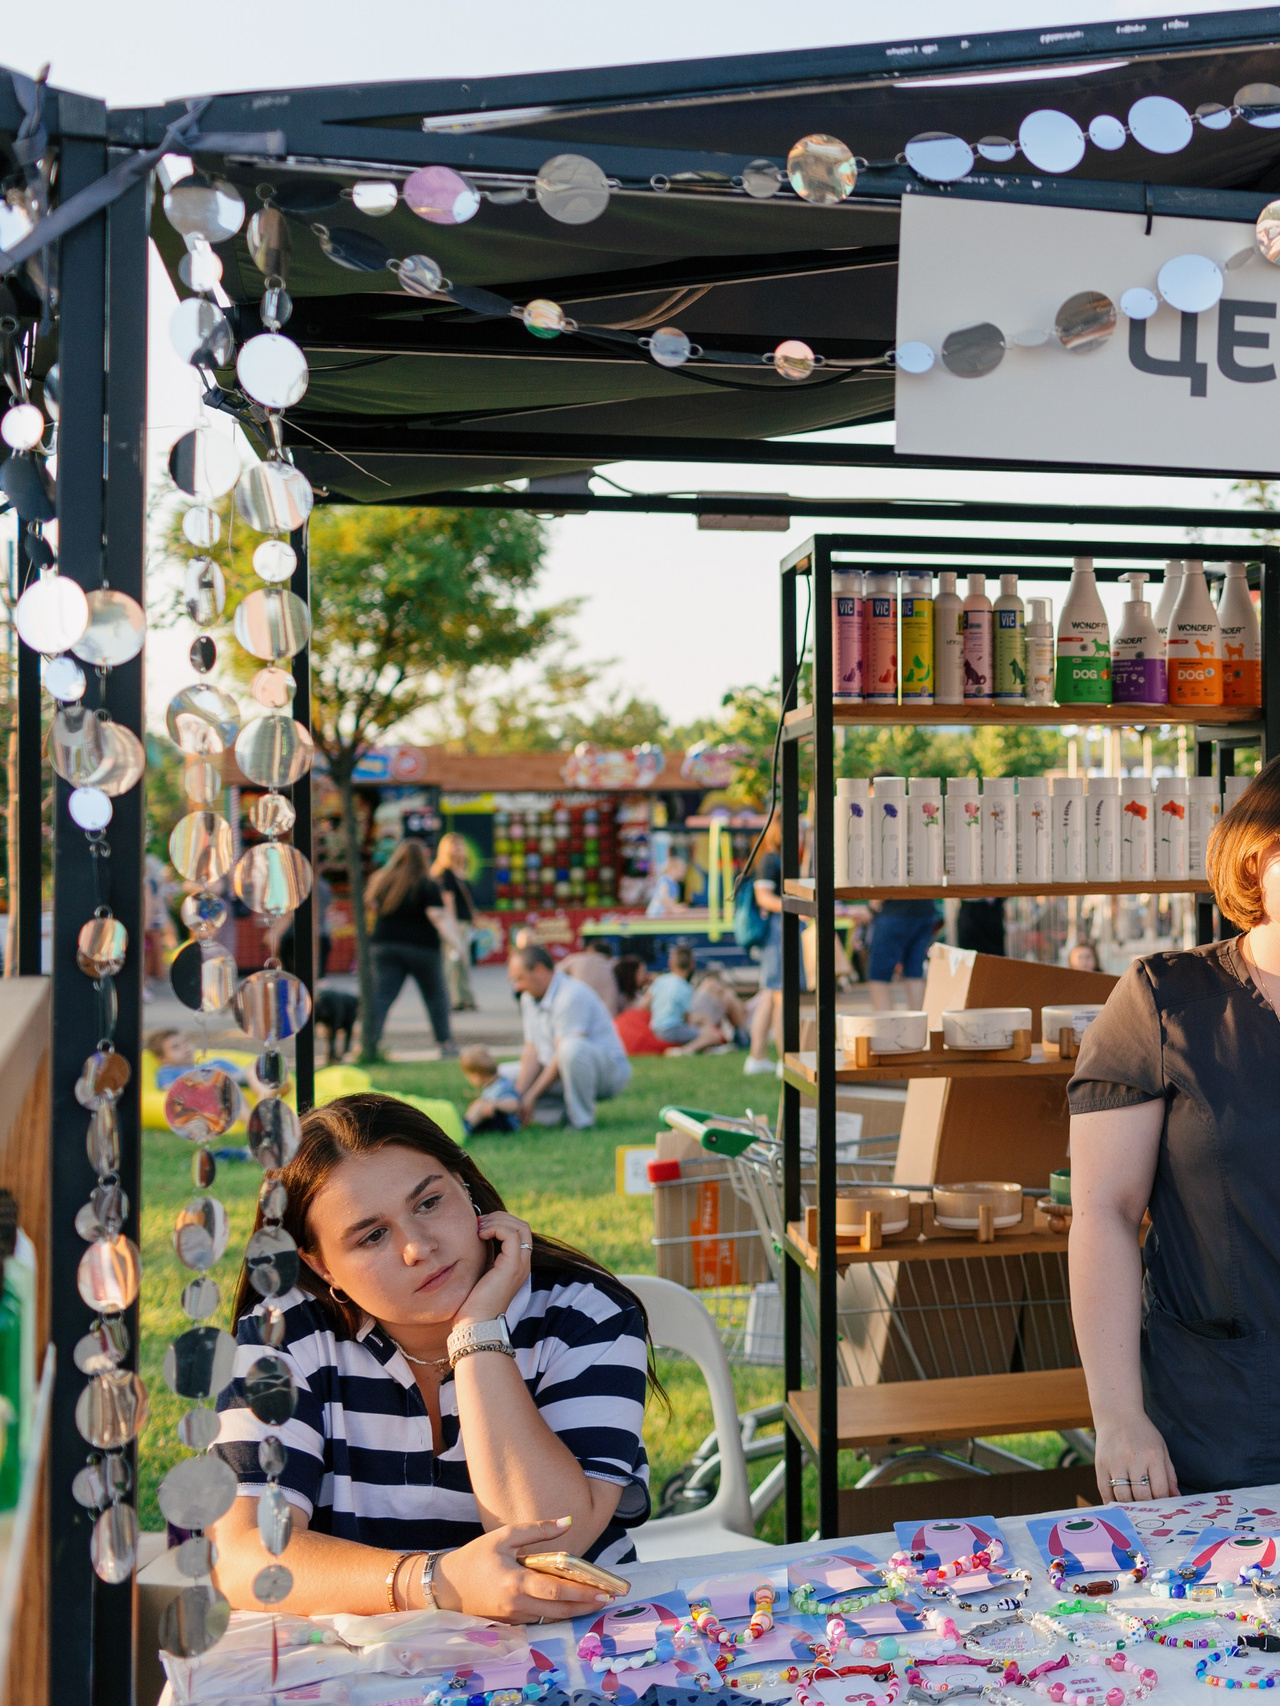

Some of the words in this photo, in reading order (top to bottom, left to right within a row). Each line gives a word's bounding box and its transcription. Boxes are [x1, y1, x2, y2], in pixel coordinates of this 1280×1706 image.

[840, 604, 854, 614] VIC
[875, 604, 889, 615] VIC
[1001, 616, 1015, 627] VIC
[1177, 623, 1213, 632] WONDER
[1073, 669, 1098, 680] DOG
[1178, 670, 1205, 681] DOG
